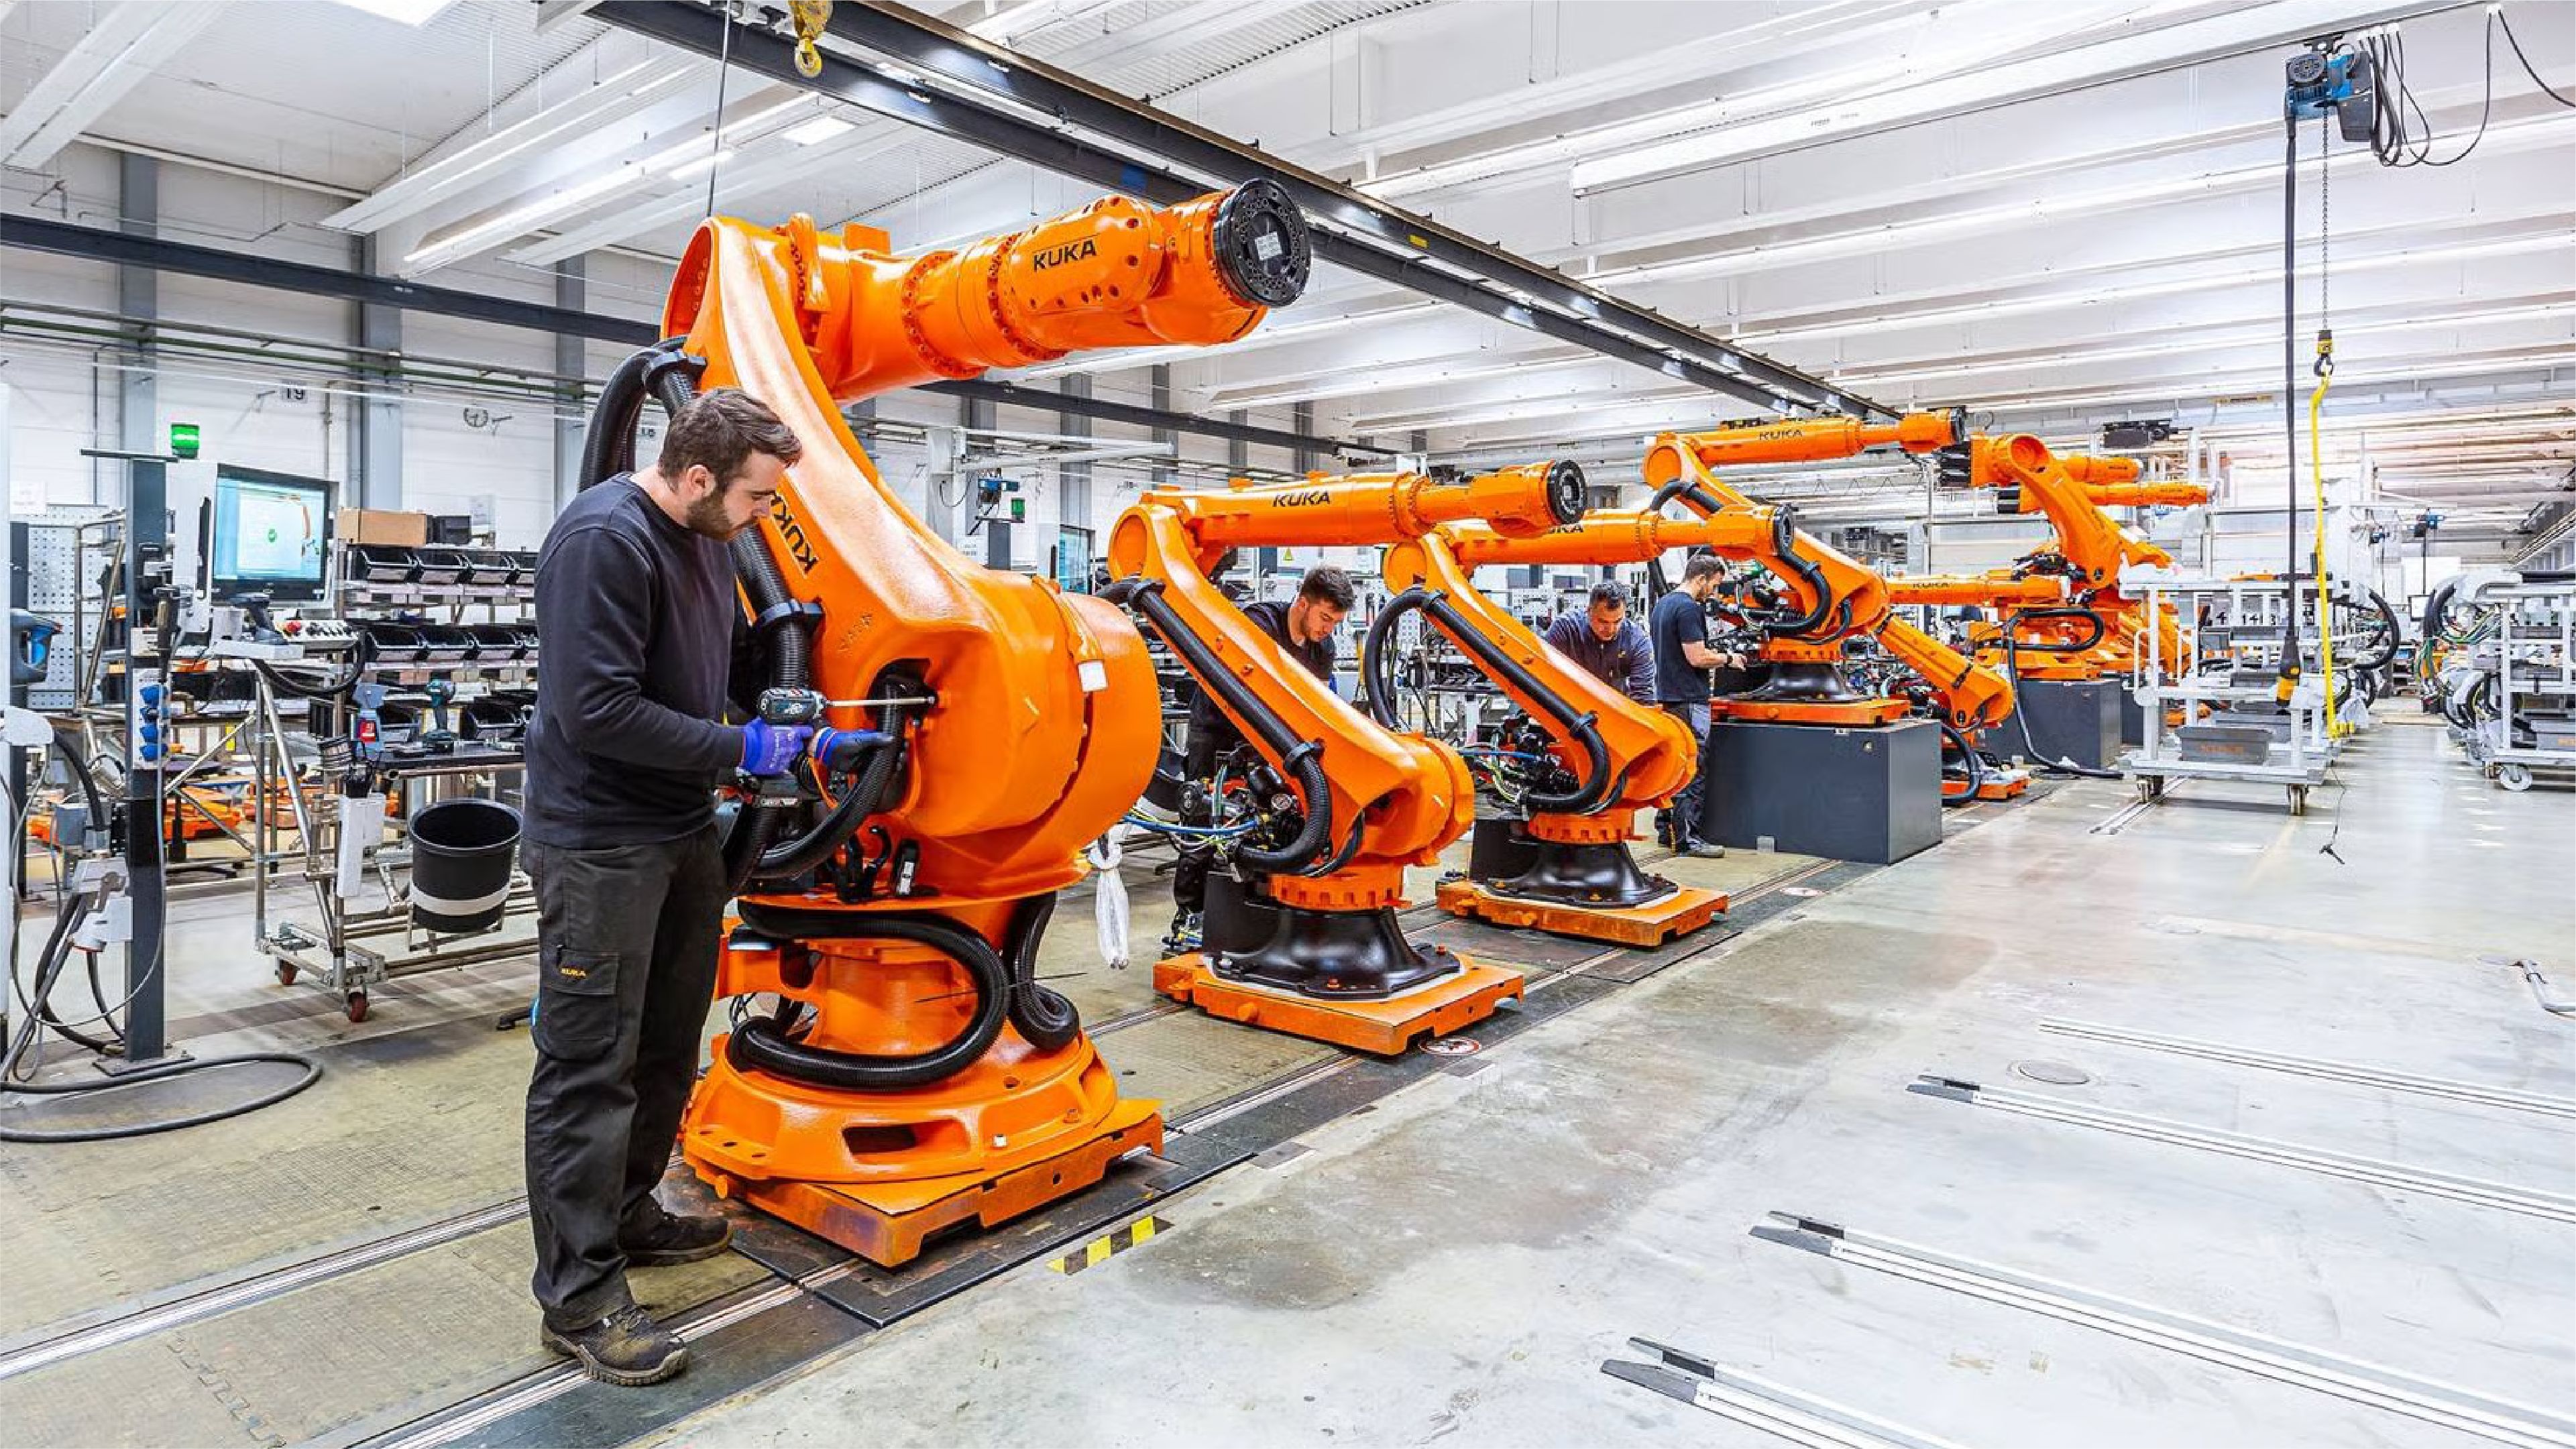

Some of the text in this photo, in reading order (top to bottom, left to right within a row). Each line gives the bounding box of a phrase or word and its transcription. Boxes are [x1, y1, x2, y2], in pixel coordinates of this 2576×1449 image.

[1033, 239, 1097, 273] KUKA
[1759, 429, 1803, 441] KUKA
[1273, 491, 1331, 508] KUKA
[771, 495, 819, 575] KUK
